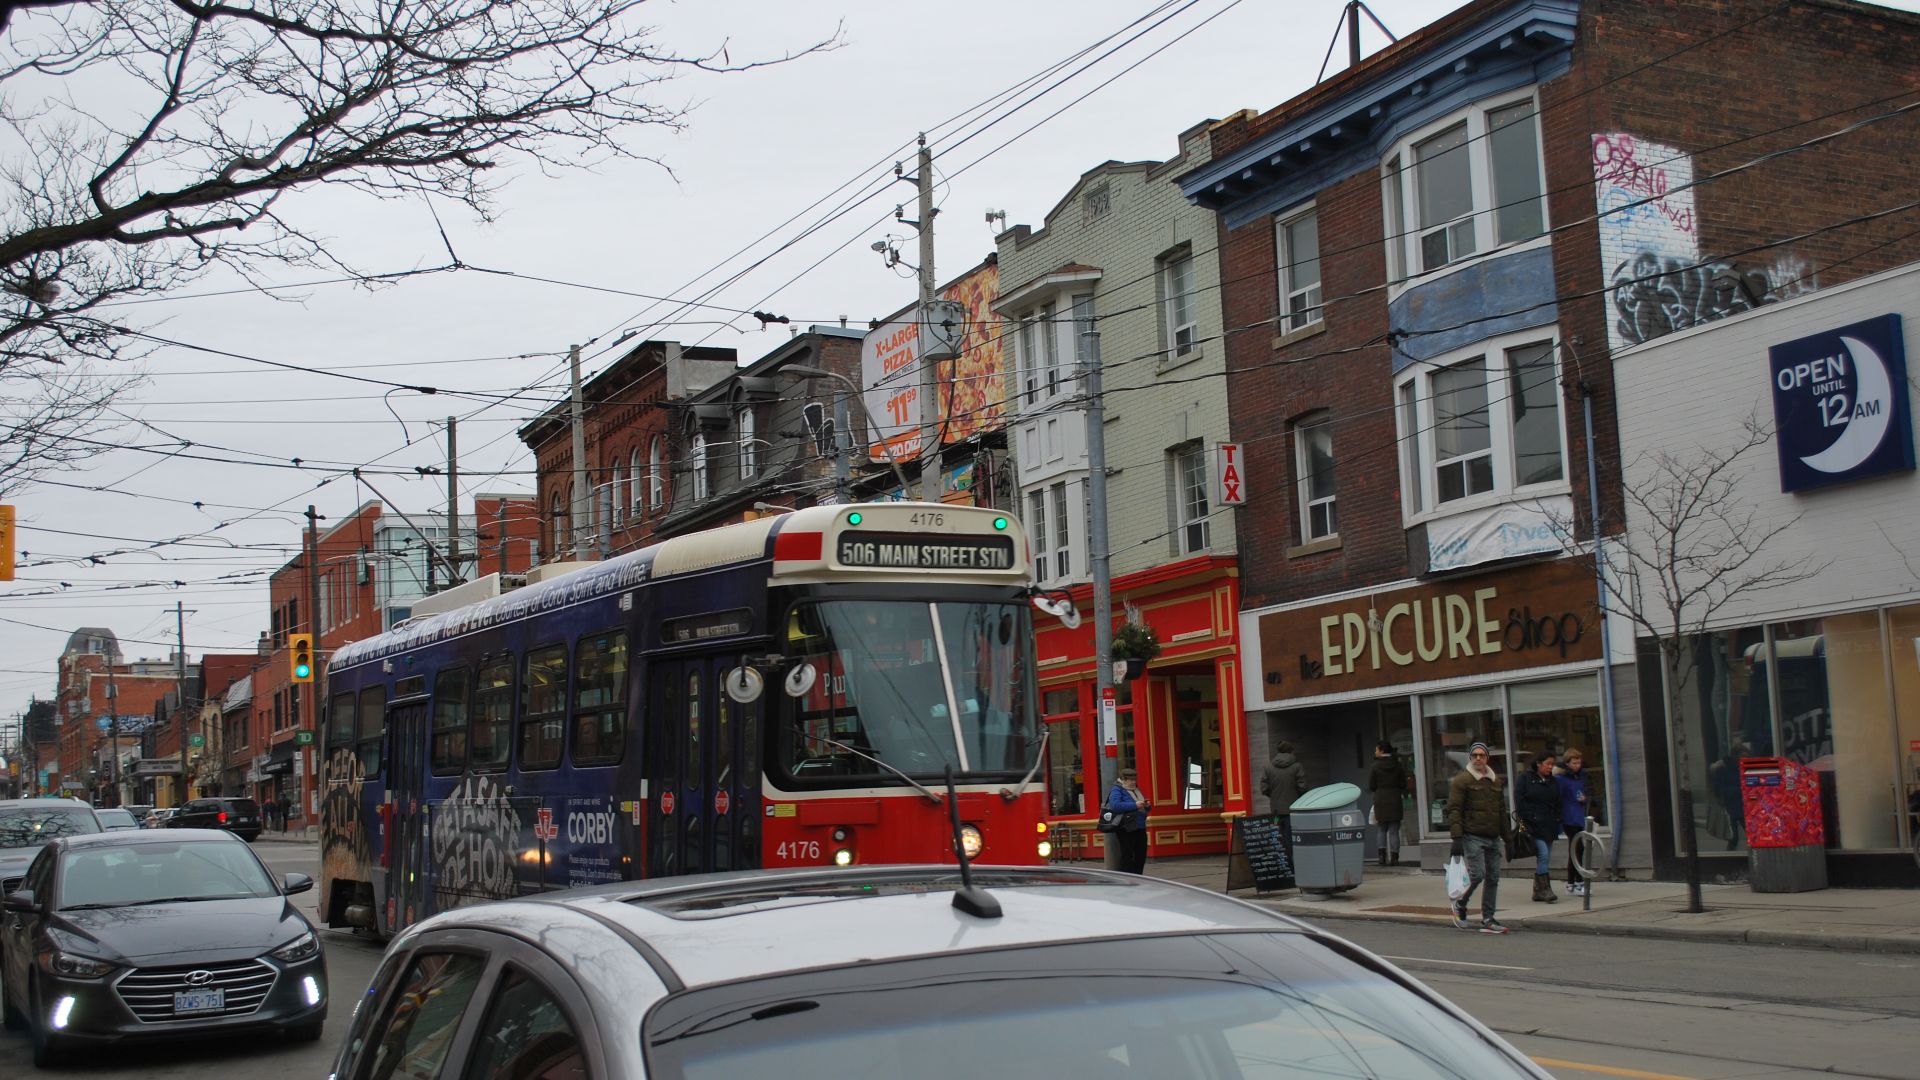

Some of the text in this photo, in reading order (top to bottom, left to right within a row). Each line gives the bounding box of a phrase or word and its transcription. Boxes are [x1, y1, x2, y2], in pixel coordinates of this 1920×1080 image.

[875, 323, 919, 358] X-LARGE
[884, 347, 913, 374] PIZZA
[1777, 353, 1845, 391] OPEN
[1812, 379, 1846, 396] UNTIL
[1817, 394, 1880, 427] 12 AM
[1221, 445, 1241, 502] TAX
[910, 513, 944, 527] 4176
[842, 543, 1008, 568] 506 MAIN STREET STN
[418, 619, 441, 645] New
[470, 606, 494, 630] Eve.
[495, 600, 531, 623] Courtesy
[530, 592, 543, 611] of
[541, 585, 570, 608] Corby
[569, 574, 597, 604] Spirit
[595, 570, 614, 592] and
[618, 559, 647, 586] Wine.
[1320, 586, 1502, 677] EPICURE
[1503, 606, 1583, 658] Shop
[298, 733, 312, 743] TD
[567, 811, 616, 845] CORBY
[1335, 831, 1353, 841] Litter
[776, 840, 820, 860] 4176
